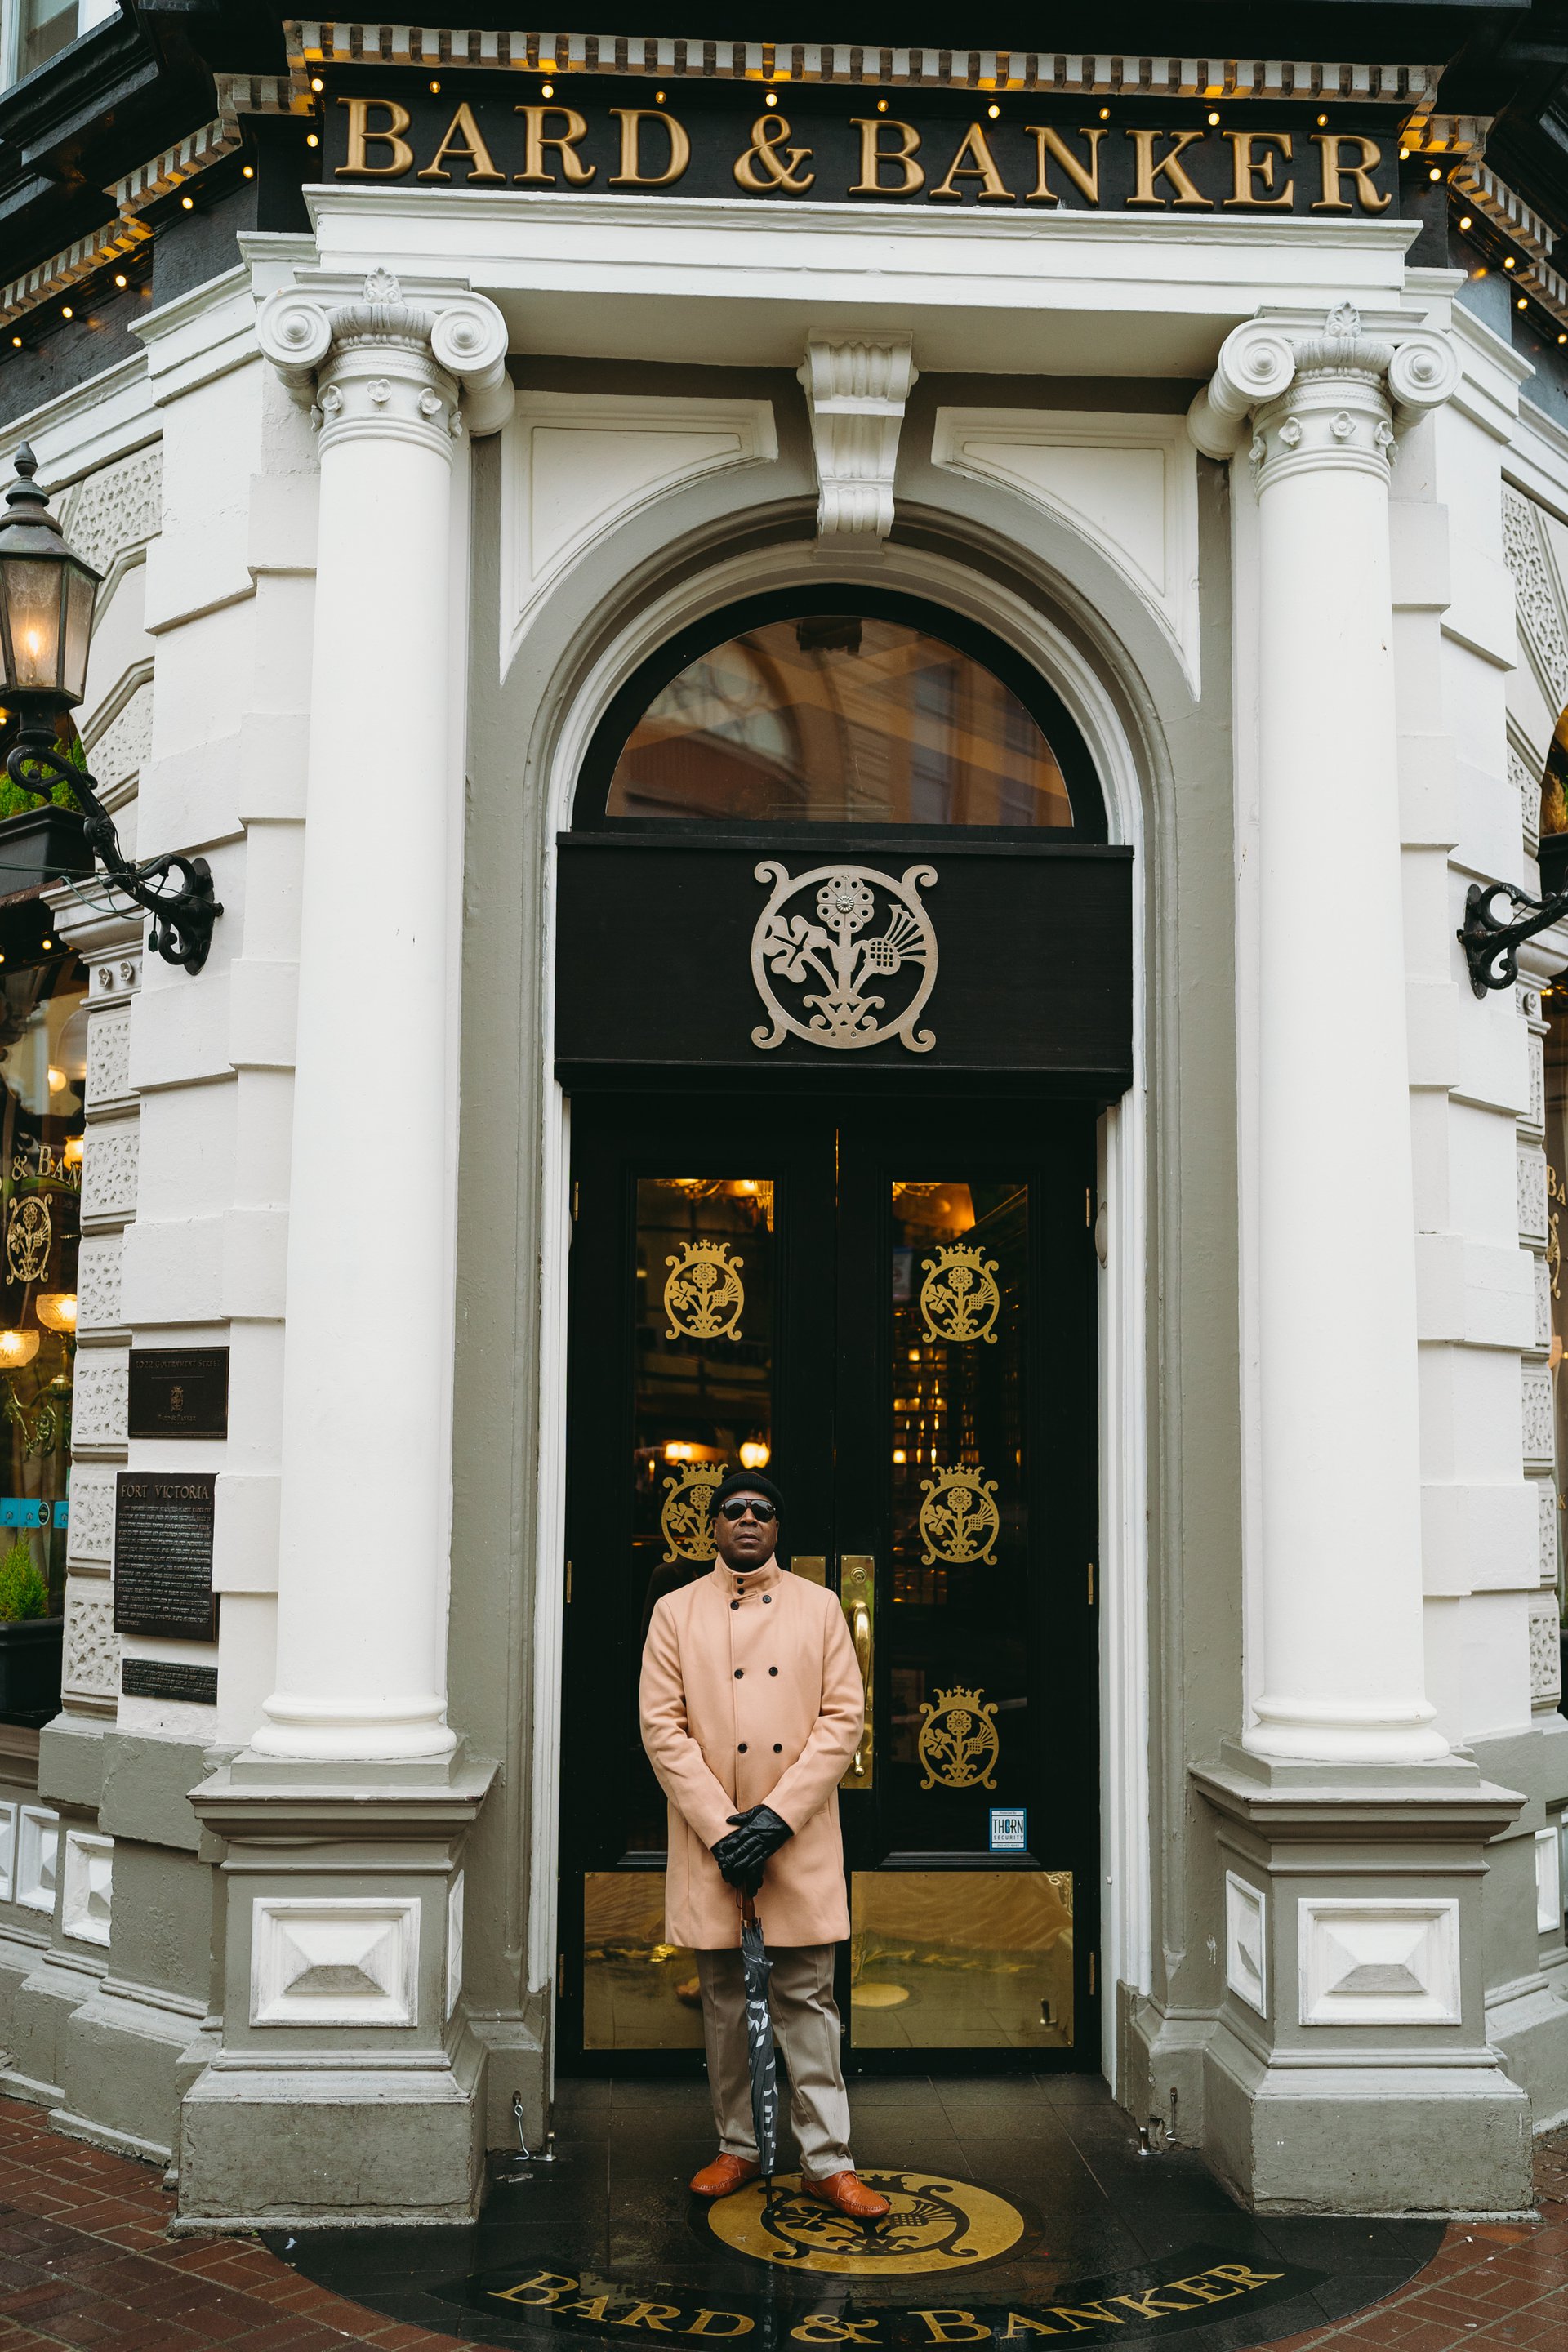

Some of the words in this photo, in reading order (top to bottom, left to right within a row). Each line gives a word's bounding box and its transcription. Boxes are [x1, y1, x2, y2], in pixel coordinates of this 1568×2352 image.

[334, 96, 692, 189] BARD
[733, 114, 816, 196] &
[848, 118, 1393, 215] BANKER
[11, 1155, 29, 1182] &
[198, 1359, 222, 1367] STREET
[121, 1484, 148, 1498] FORT
[154, 1485, 210, 1499] VICTORIA
[992, 1819, 1023, 1833] THORN
[487, 2270, 755, 2336] BARD
[790, 2314, 884, 2345] &
[907, 2263, 1287, 2345] BANKER
